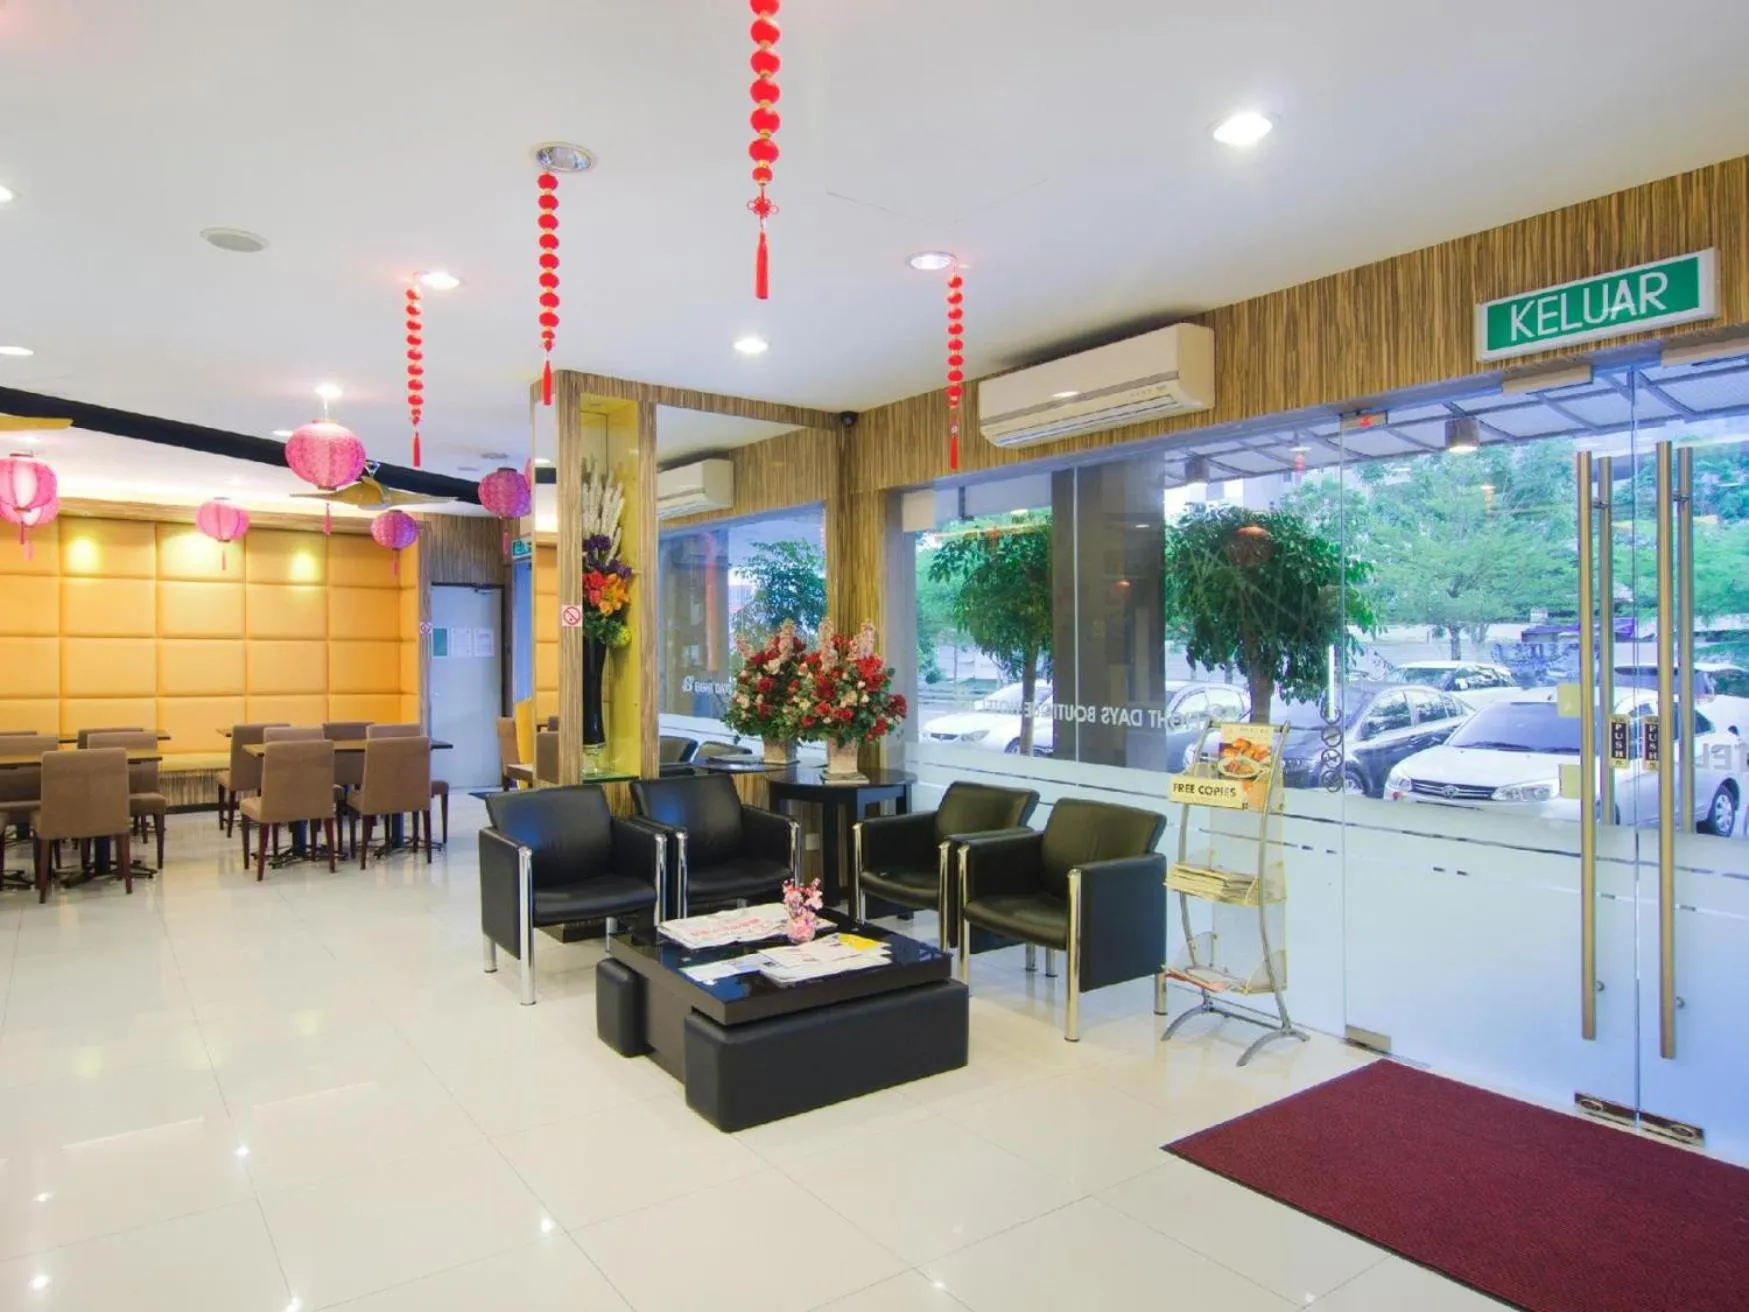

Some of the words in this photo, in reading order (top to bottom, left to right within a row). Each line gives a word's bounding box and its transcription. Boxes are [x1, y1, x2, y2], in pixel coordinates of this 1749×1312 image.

[1511, 271, 1668, 341] KELUAR
[1613, 723, 1624, 758] PUSH
[1648, 725, 1659, 760] PUSH
[1173, 783, 1195, 794] FREE
[1198, 785, 1237, 797] COPIES
